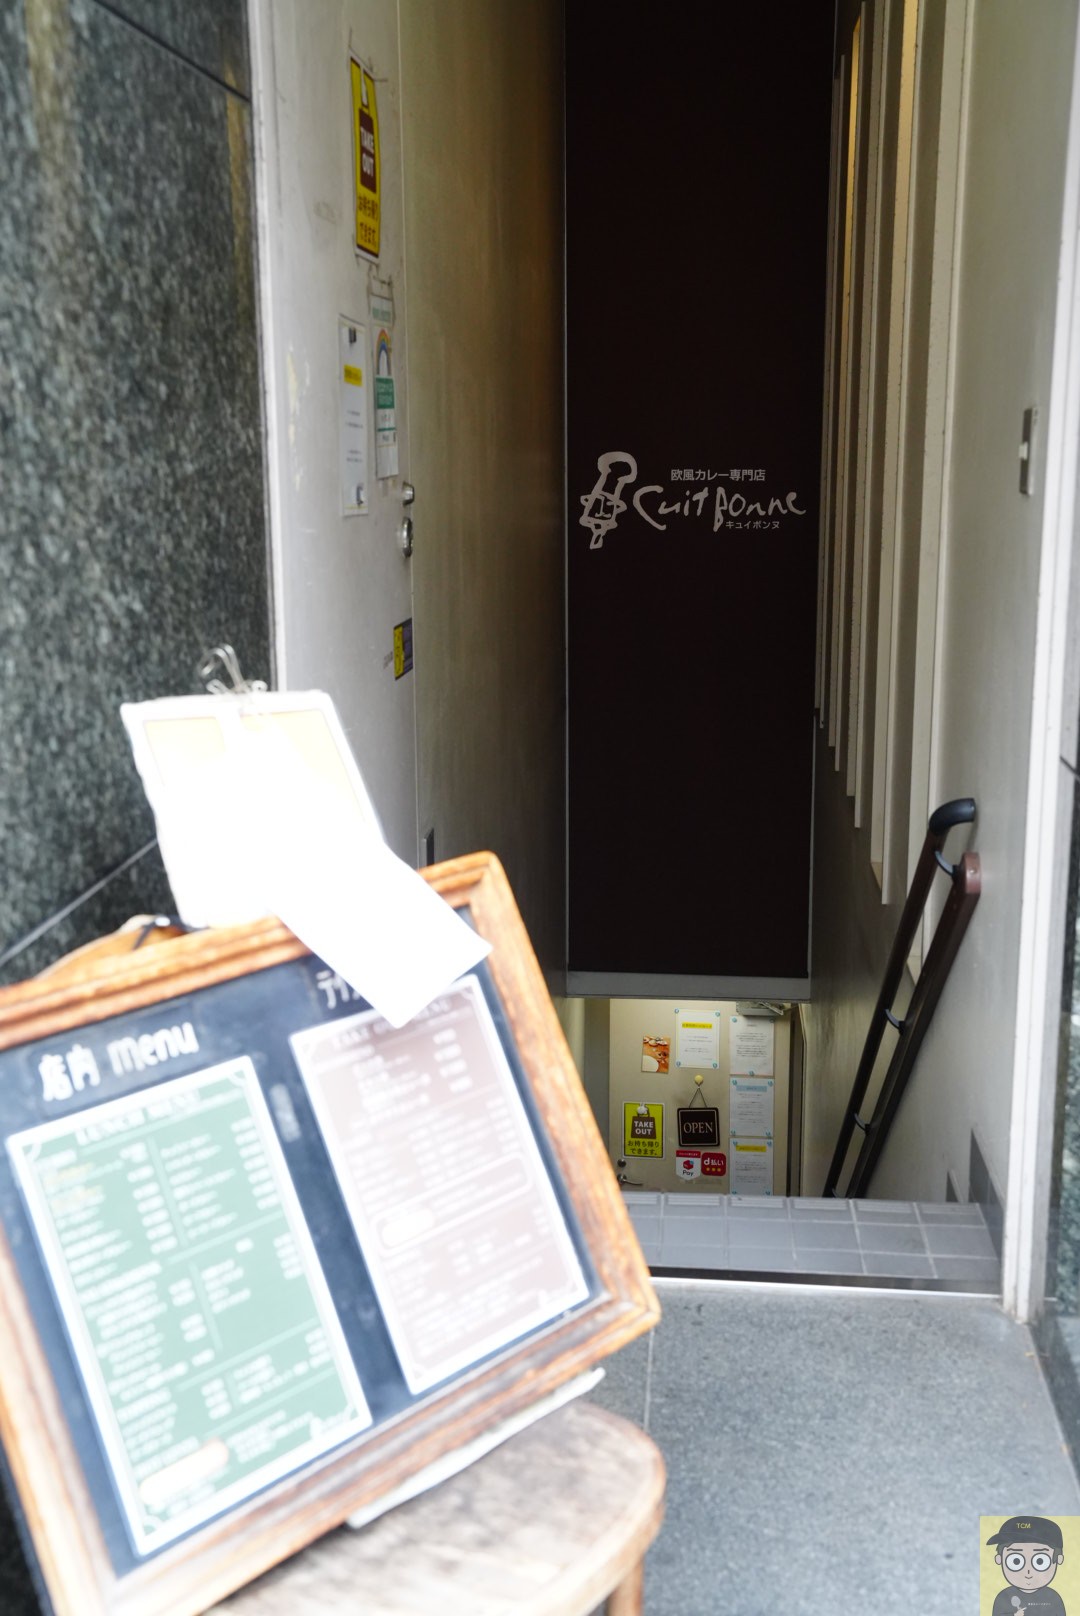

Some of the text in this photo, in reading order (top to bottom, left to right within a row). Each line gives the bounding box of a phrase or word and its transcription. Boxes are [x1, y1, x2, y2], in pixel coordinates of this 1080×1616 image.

[670, 468, 766, 482] 欧風カレー専門店
[633, 1120, 654, 1129] TAKE
[683, 1122, 713, 1134] OPEN
[635, 1128, 652, 1136] OUT
[628, 1140, 660, 1148] お持ち帰り
[682, 1169, 694, 1177] Pay
